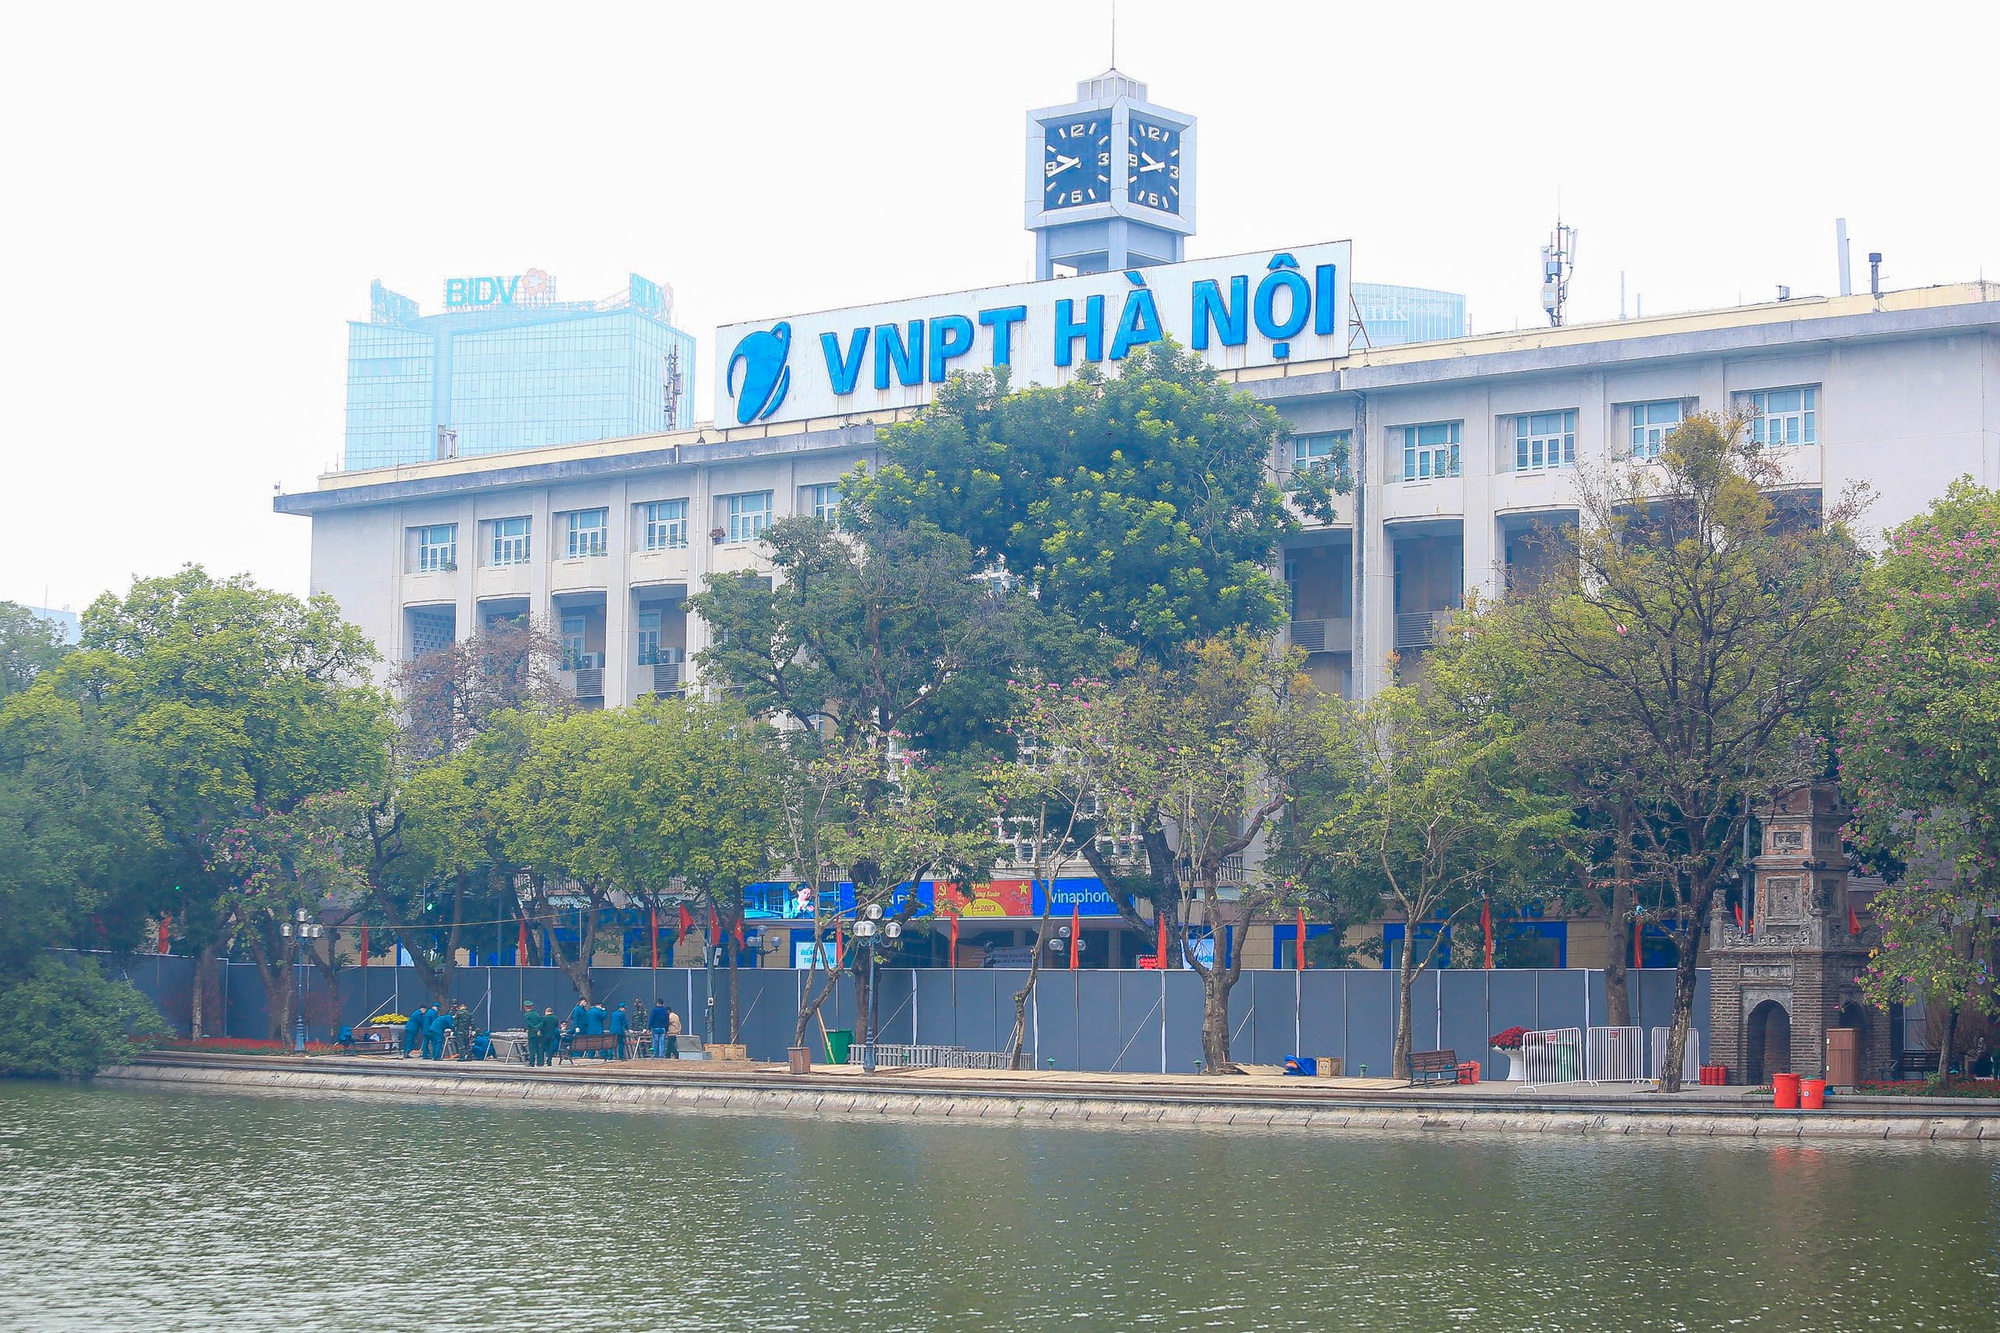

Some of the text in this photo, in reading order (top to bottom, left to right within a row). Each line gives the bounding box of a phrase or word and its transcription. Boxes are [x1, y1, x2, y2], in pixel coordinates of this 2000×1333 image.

[1070, 123, 1085, 138] 12
[1148, 126, 1160, 142] 12
[1097, 152, 1110, 167] 3
[1169, 164, 1179, 179] 3
[1070, 190, 1083, 204] 6
[1147, 191, 1159, 206] 6
[446, 275, 522, 306] BIDV
[819, 252, 1336, 396] VNPT HÀ NỘI
[1050, 888, 1114, 906] vinaphon
[980, 904, 996, 912] 2023
